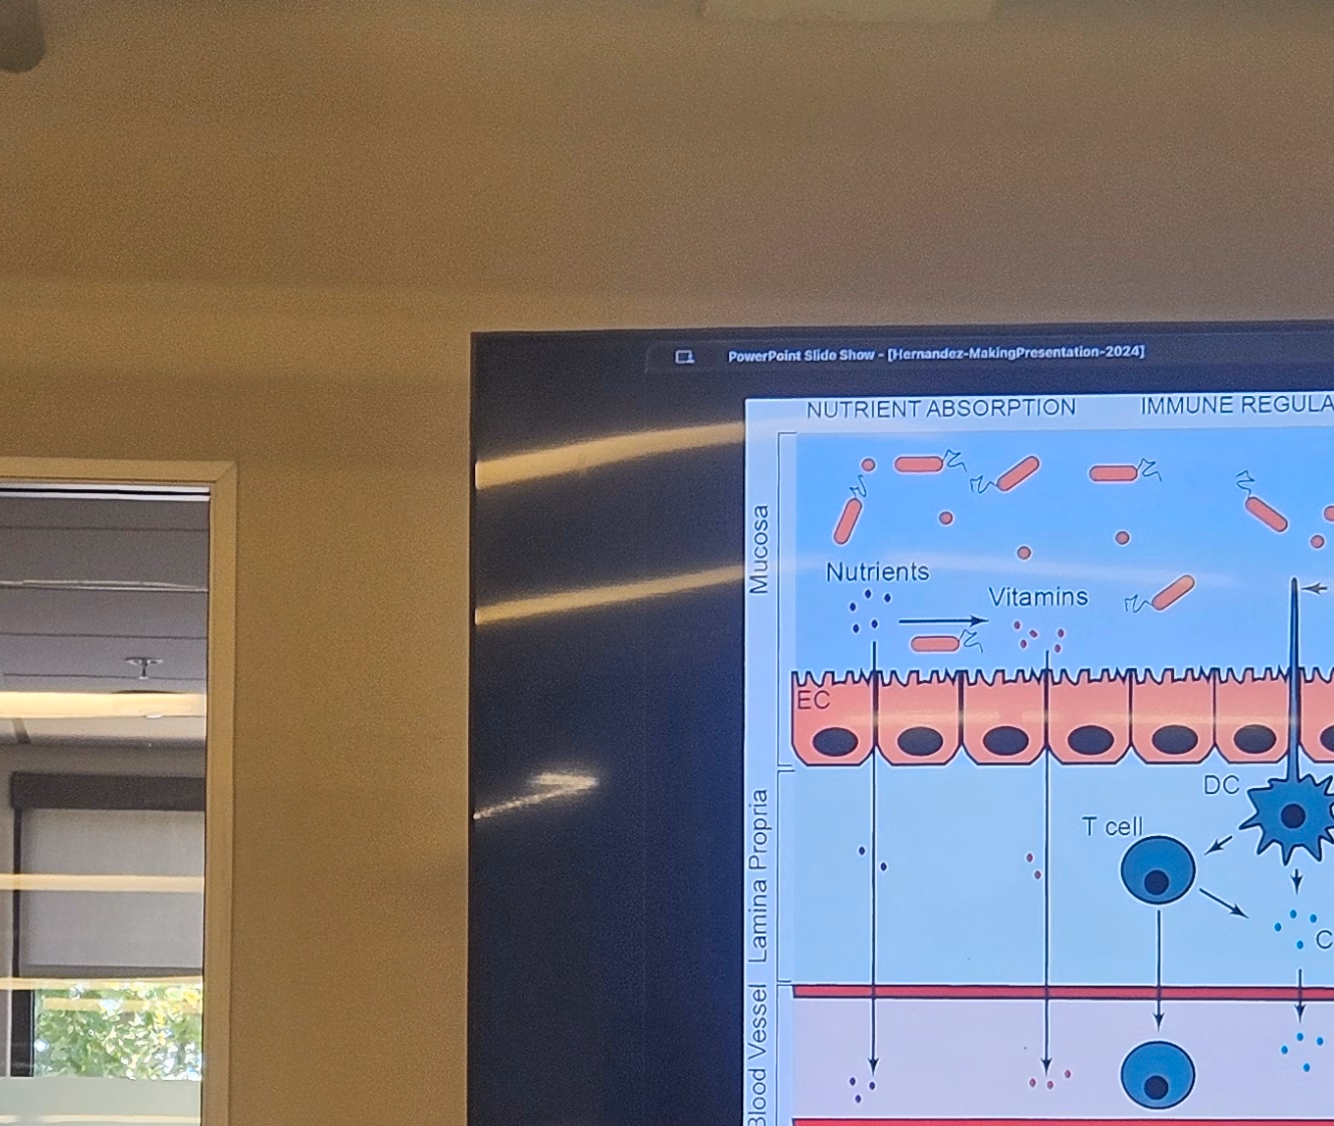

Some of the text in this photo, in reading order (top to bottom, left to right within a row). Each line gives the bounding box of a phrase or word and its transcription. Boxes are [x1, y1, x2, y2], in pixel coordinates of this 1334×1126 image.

[728, 350, 802, 363] PowerPoint
[804, 349, 837, 362] Slide
[839, 348, 876, 361] Show
[887, 345, 1146, 362] [Hernandez-MakingPresentation-2024]
[807, 397, 1076, 419] NUTRIENT ABSORPTION
[1141, 395, 1233, 415] IMMUNE
[749, 504, 770, 595] Mucosa
[826, 560, 930, 583] Nutrients
[989, 585, 1089, 608] Vitamins
[797, 690, 830, 710] EC
[1204, 774, 1240, 795] DC
[1082, 816, 1143, 837] T cell
[748, 788, 772, 964] Lamina Propria
[748, 983, 769, 1061] Vessel
